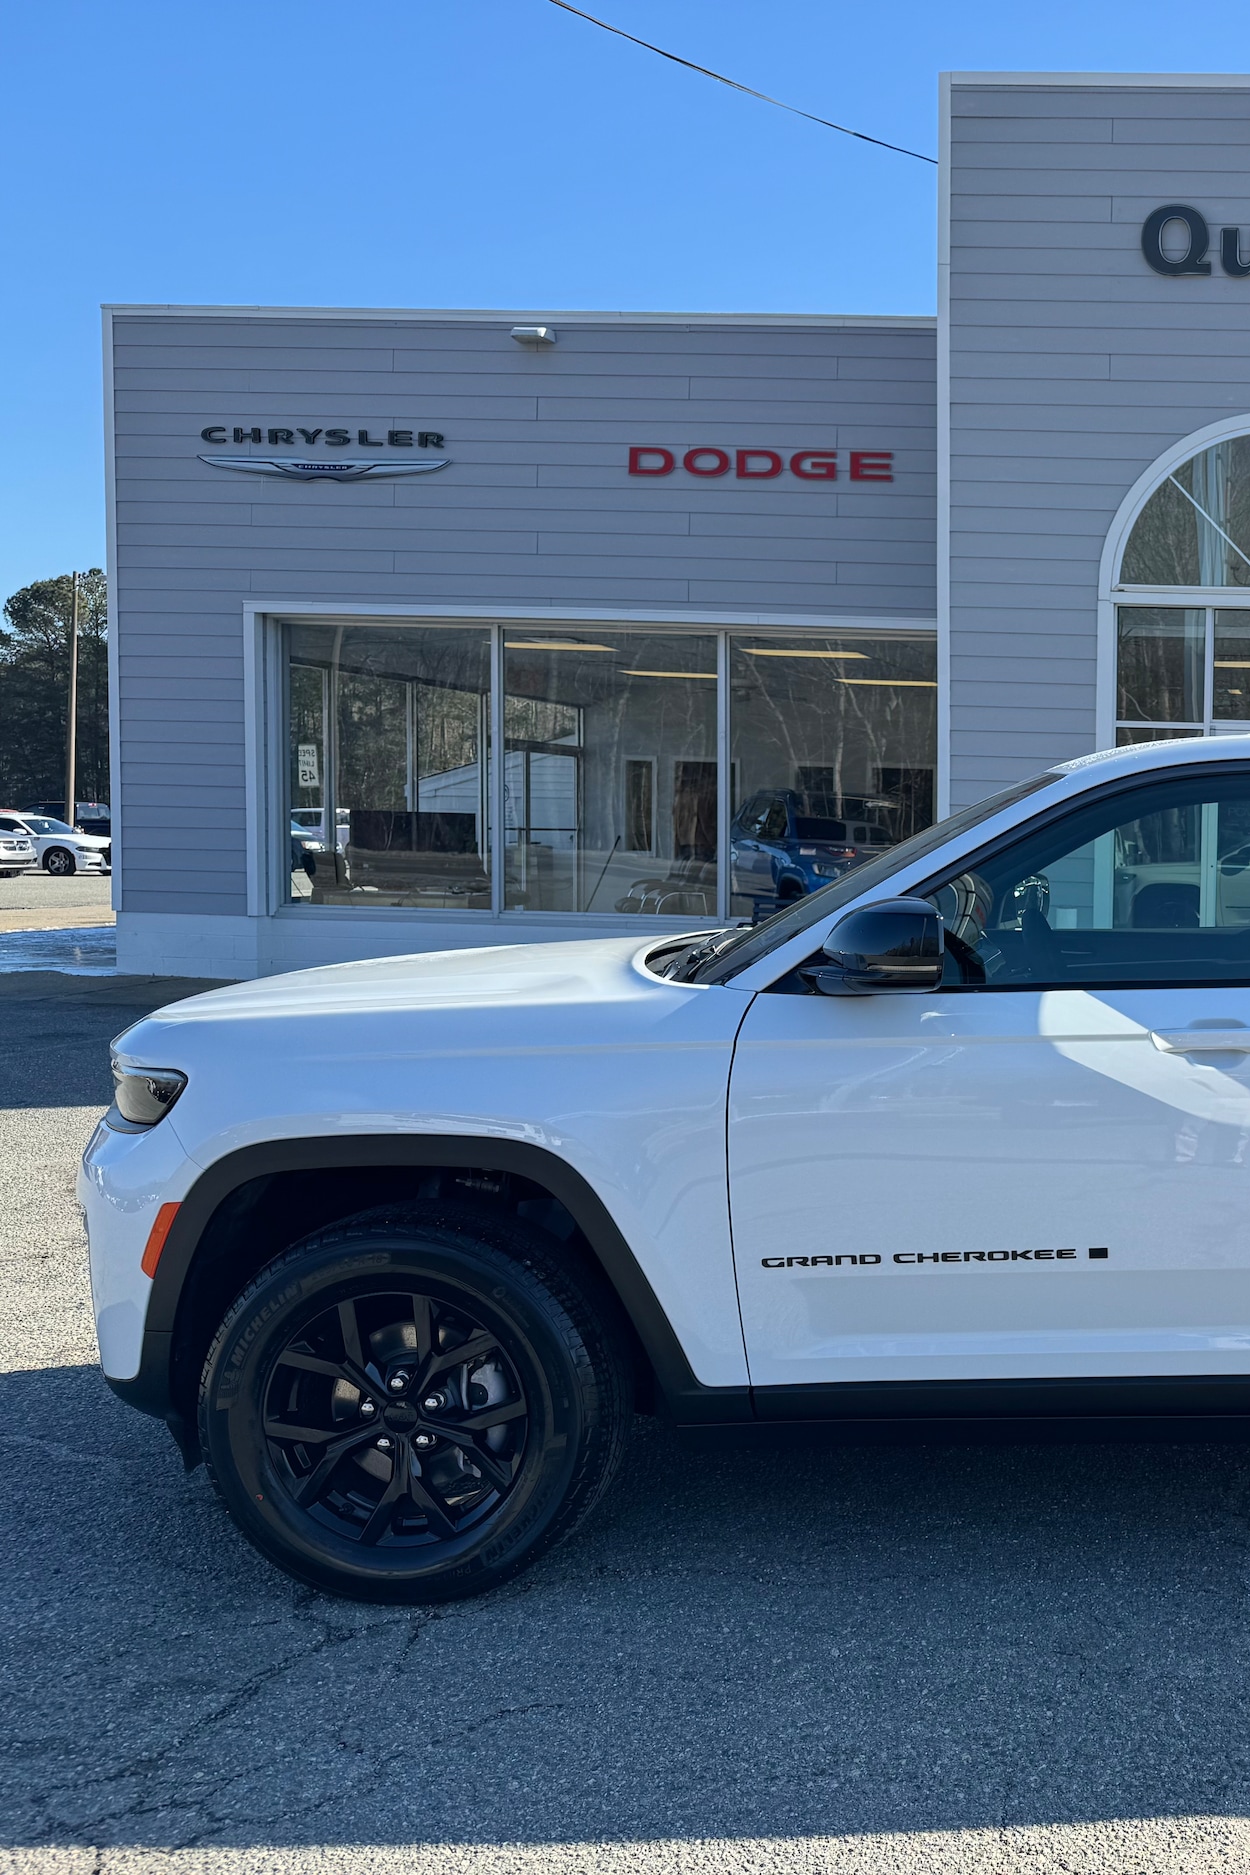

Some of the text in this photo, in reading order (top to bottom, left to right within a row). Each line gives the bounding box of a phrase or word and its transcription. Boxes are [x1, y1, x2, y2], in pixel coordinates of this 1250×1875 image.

[200, 426, 445, 448] CHRYSLER
[628, 446, 894, 482] DODGE
[761, 1248, 1077, 1268] GRAND CHEROKEE
[230, 1281, 298, 1367] MICHELIN
